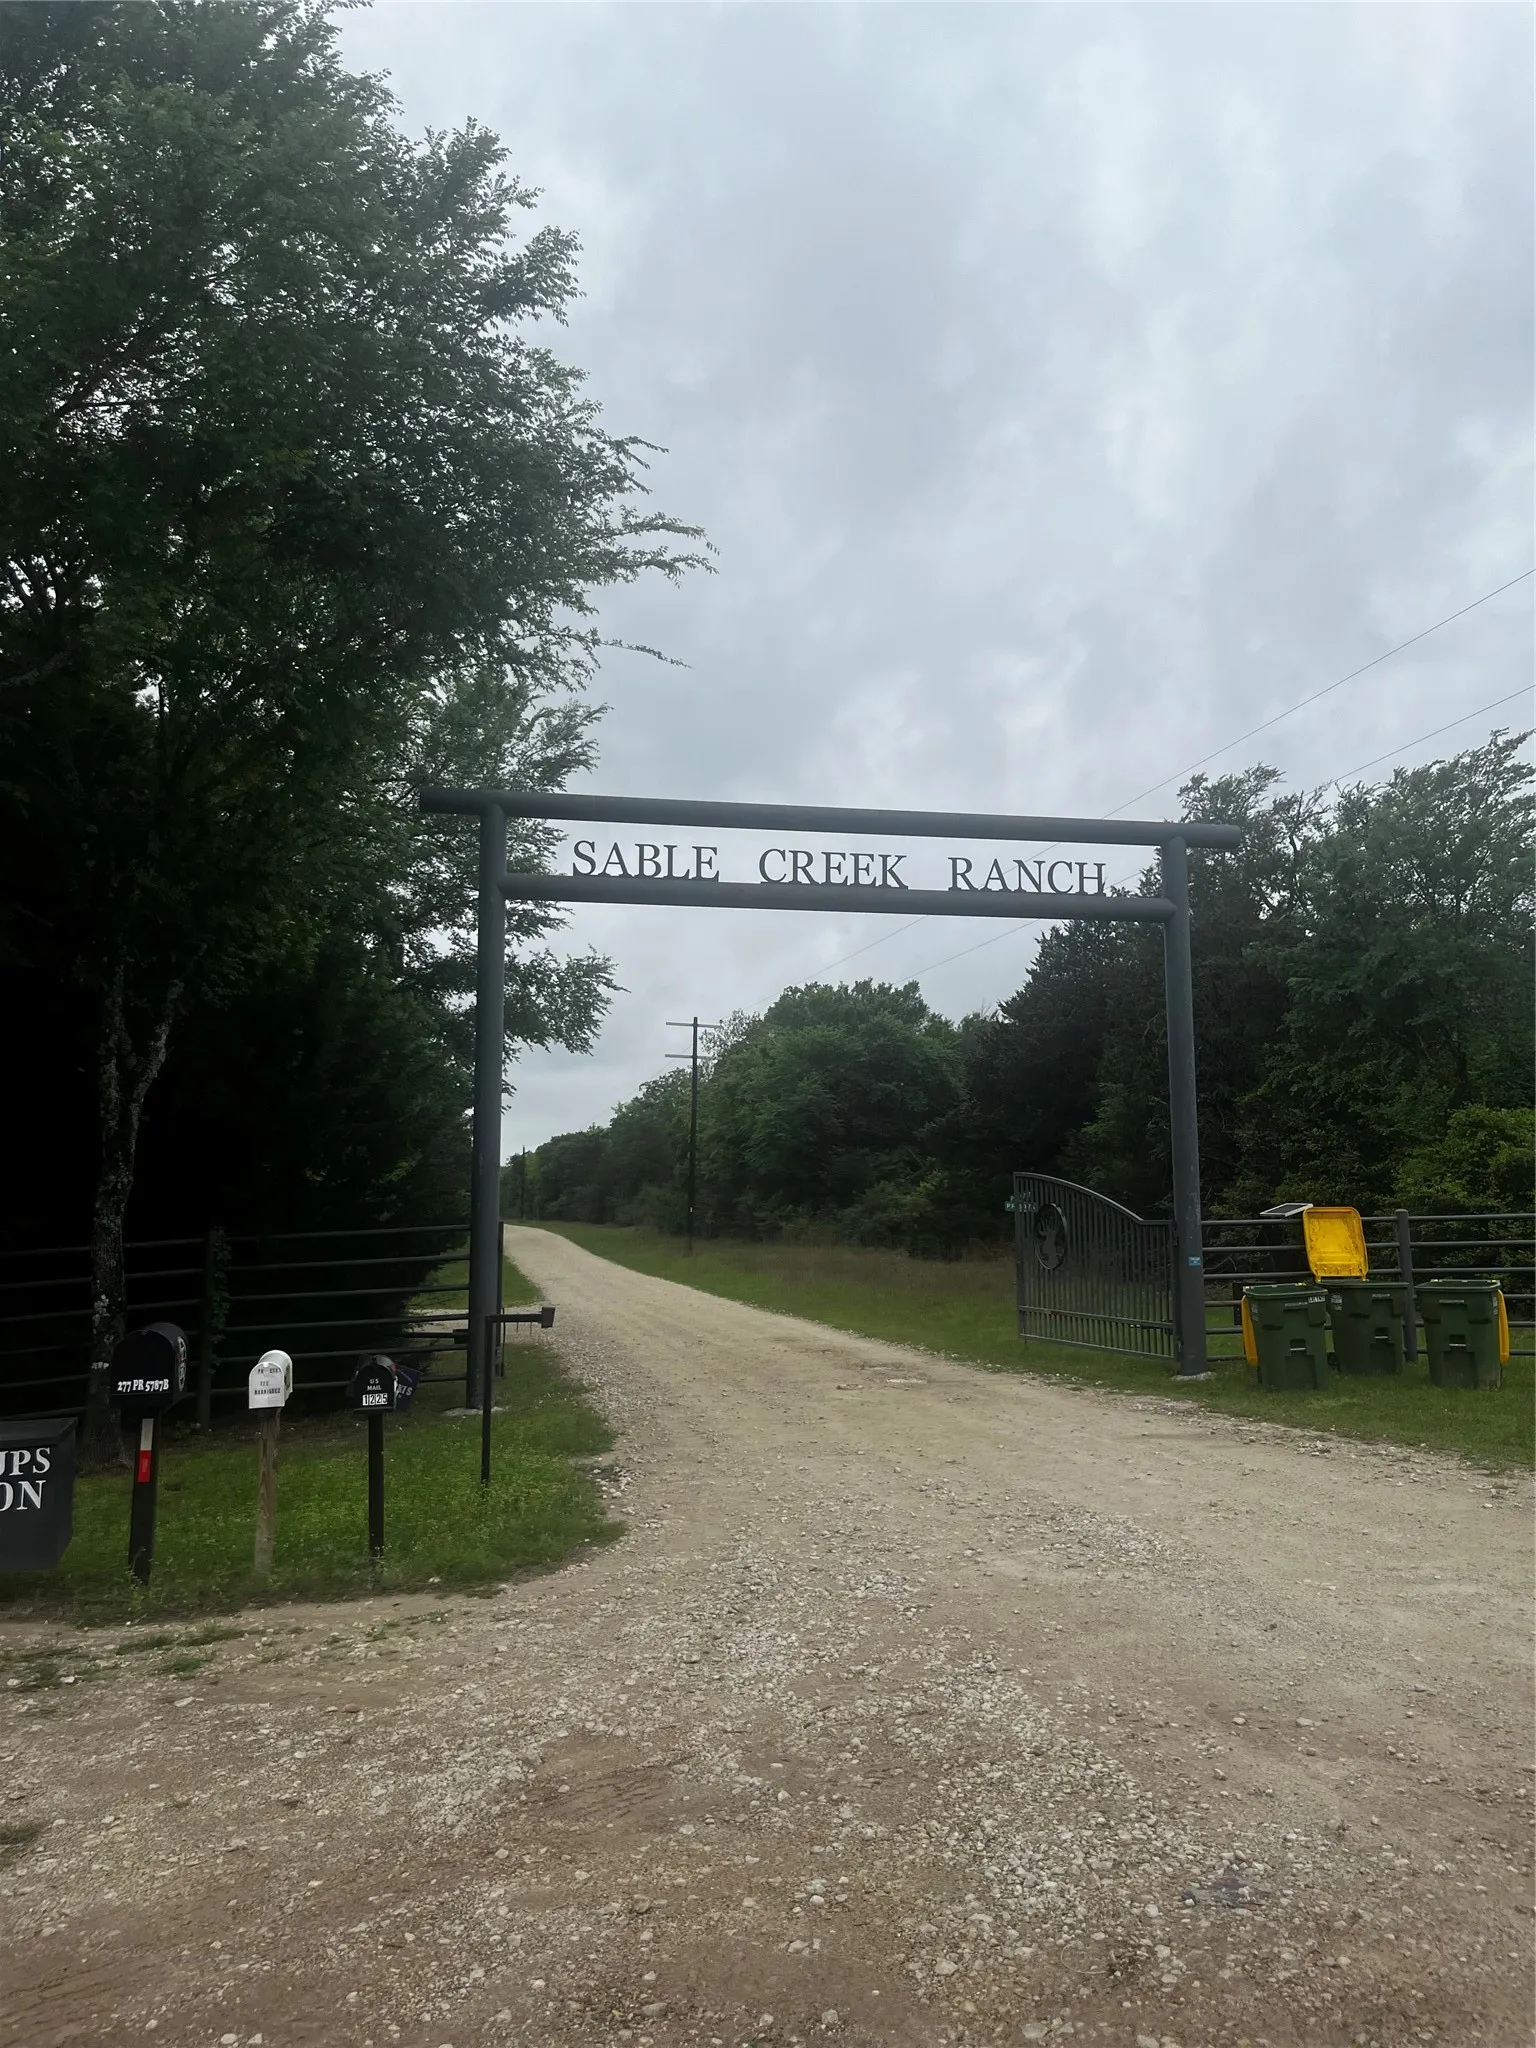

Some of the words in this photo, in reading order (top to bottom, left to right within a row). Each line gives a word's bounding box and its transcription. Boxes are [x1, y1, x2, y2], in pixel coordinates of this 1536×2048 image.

[572, 839, 719, 880] SABLE
[758, 848, 908, 889] CREEK
[947, 856, 1106, 896] RANCH
[117, 1380, 131, 1392] 277
[132, 1379, 144, 1391] PR
[145, 1378, 169, 1392] 5787B
[363, 1393, 388, 1405] 1225
